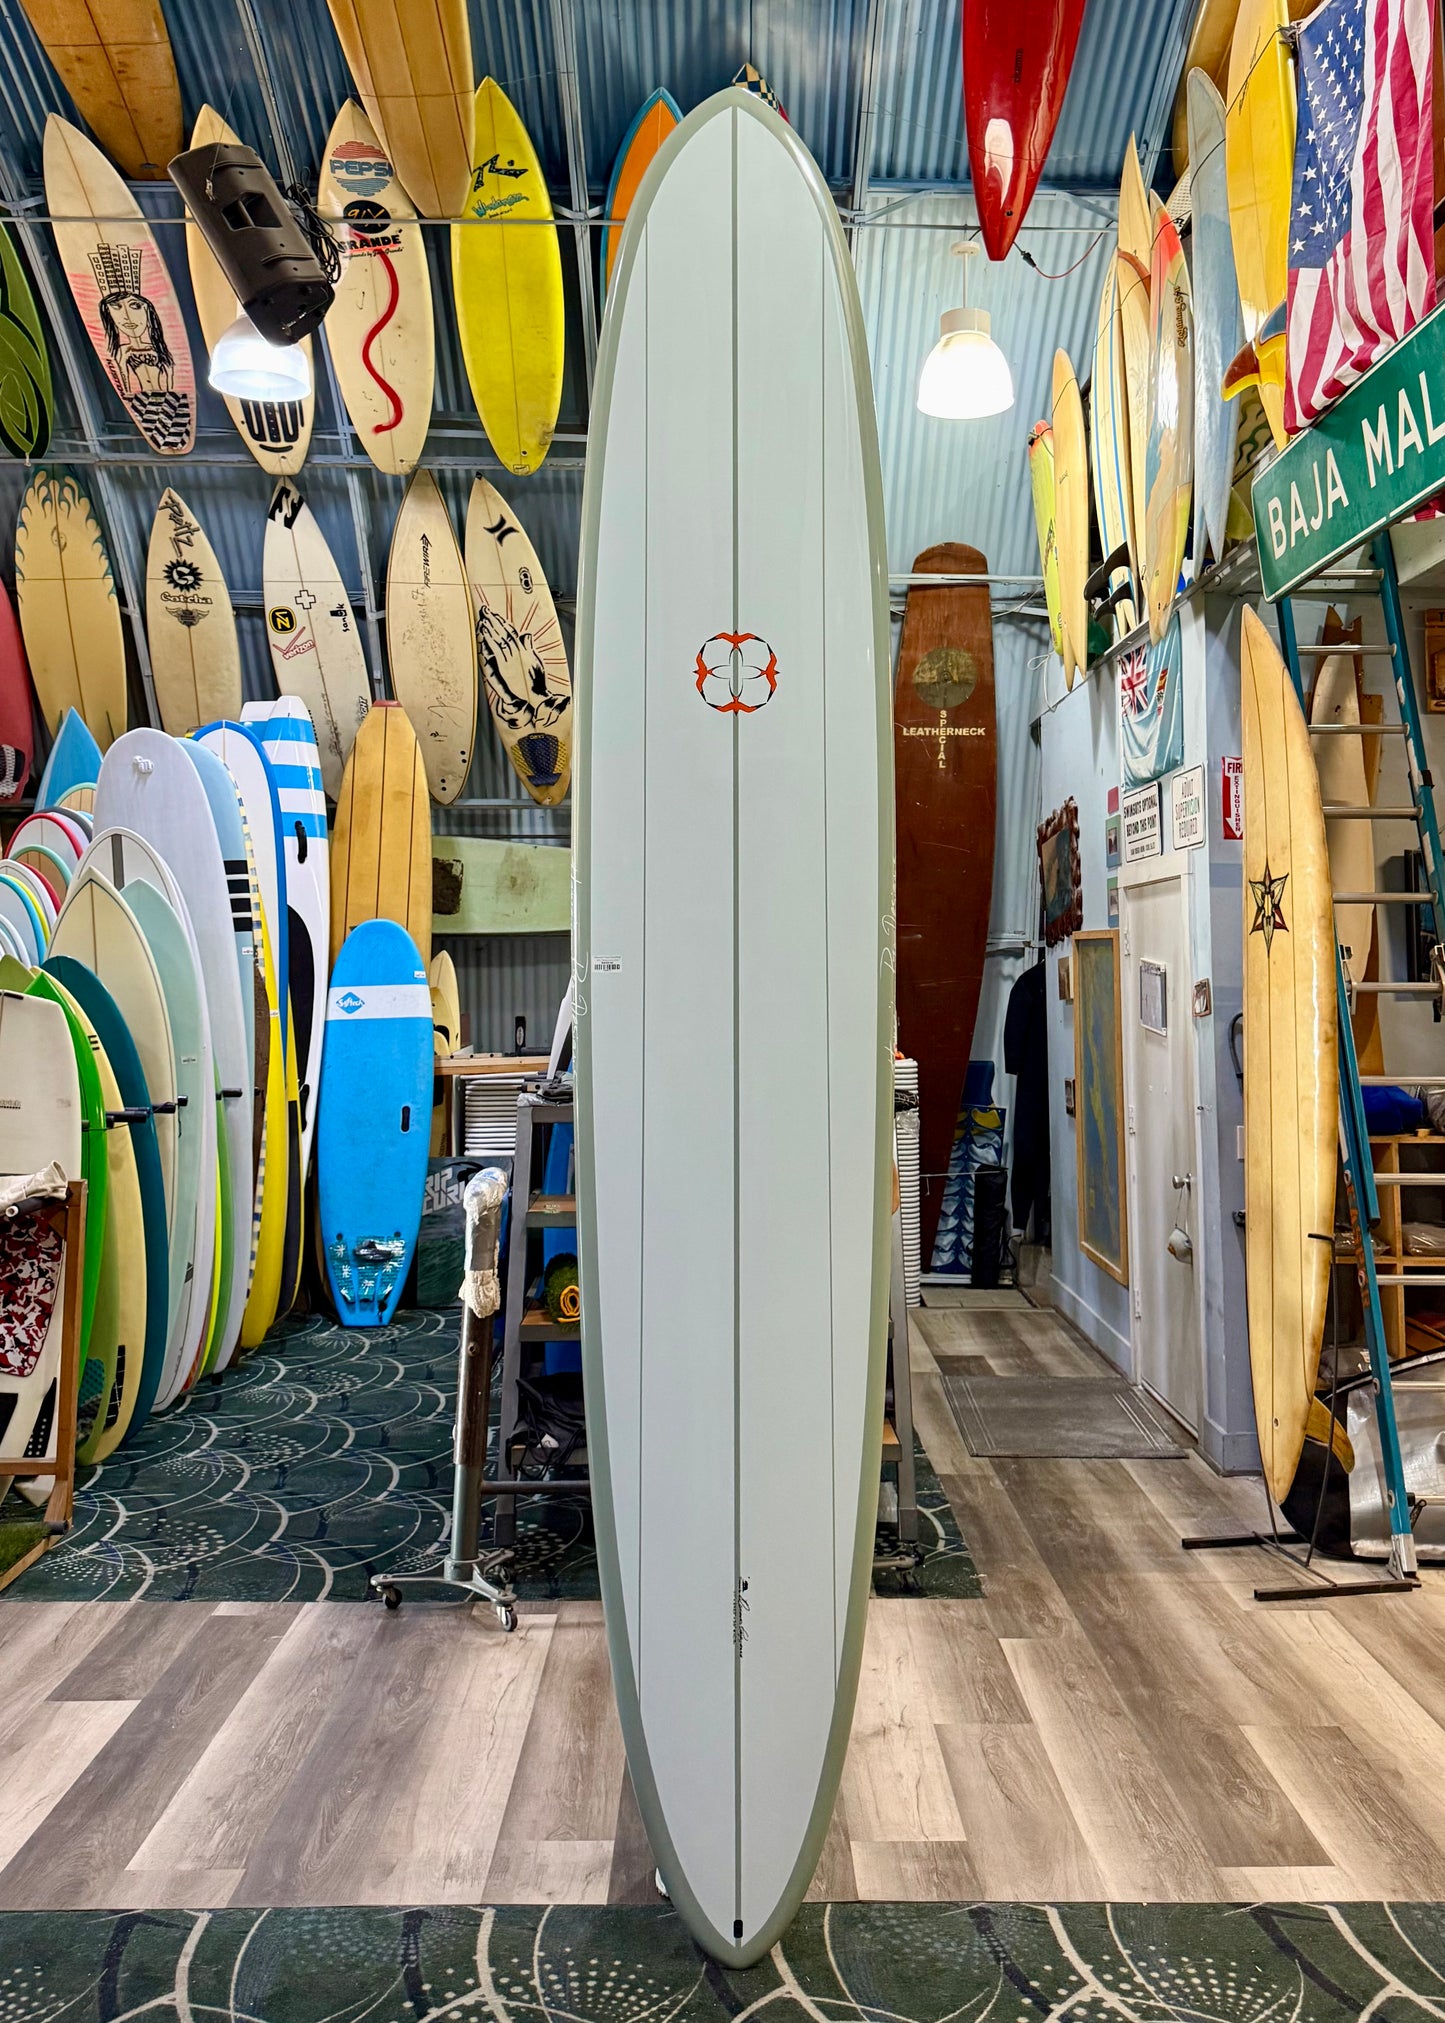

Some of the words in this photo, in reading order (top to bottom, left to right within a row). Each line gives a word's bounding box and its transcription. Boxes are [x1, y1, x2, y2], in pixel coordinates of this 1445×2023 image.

[330, 160, 393, 177] PEPSI
[1268, 447, 1349, 561] BAJA
[160, 591, 213, 605] Gotcha
[282, 640, 316, 660] verizon
[902, 727, 986, 736] LEATHERNECK
[937, 709, 948, 769] SPECIAL
[1227, 762, 1243, 774] FIR
[425, 1167, 453, 1194] RIP
